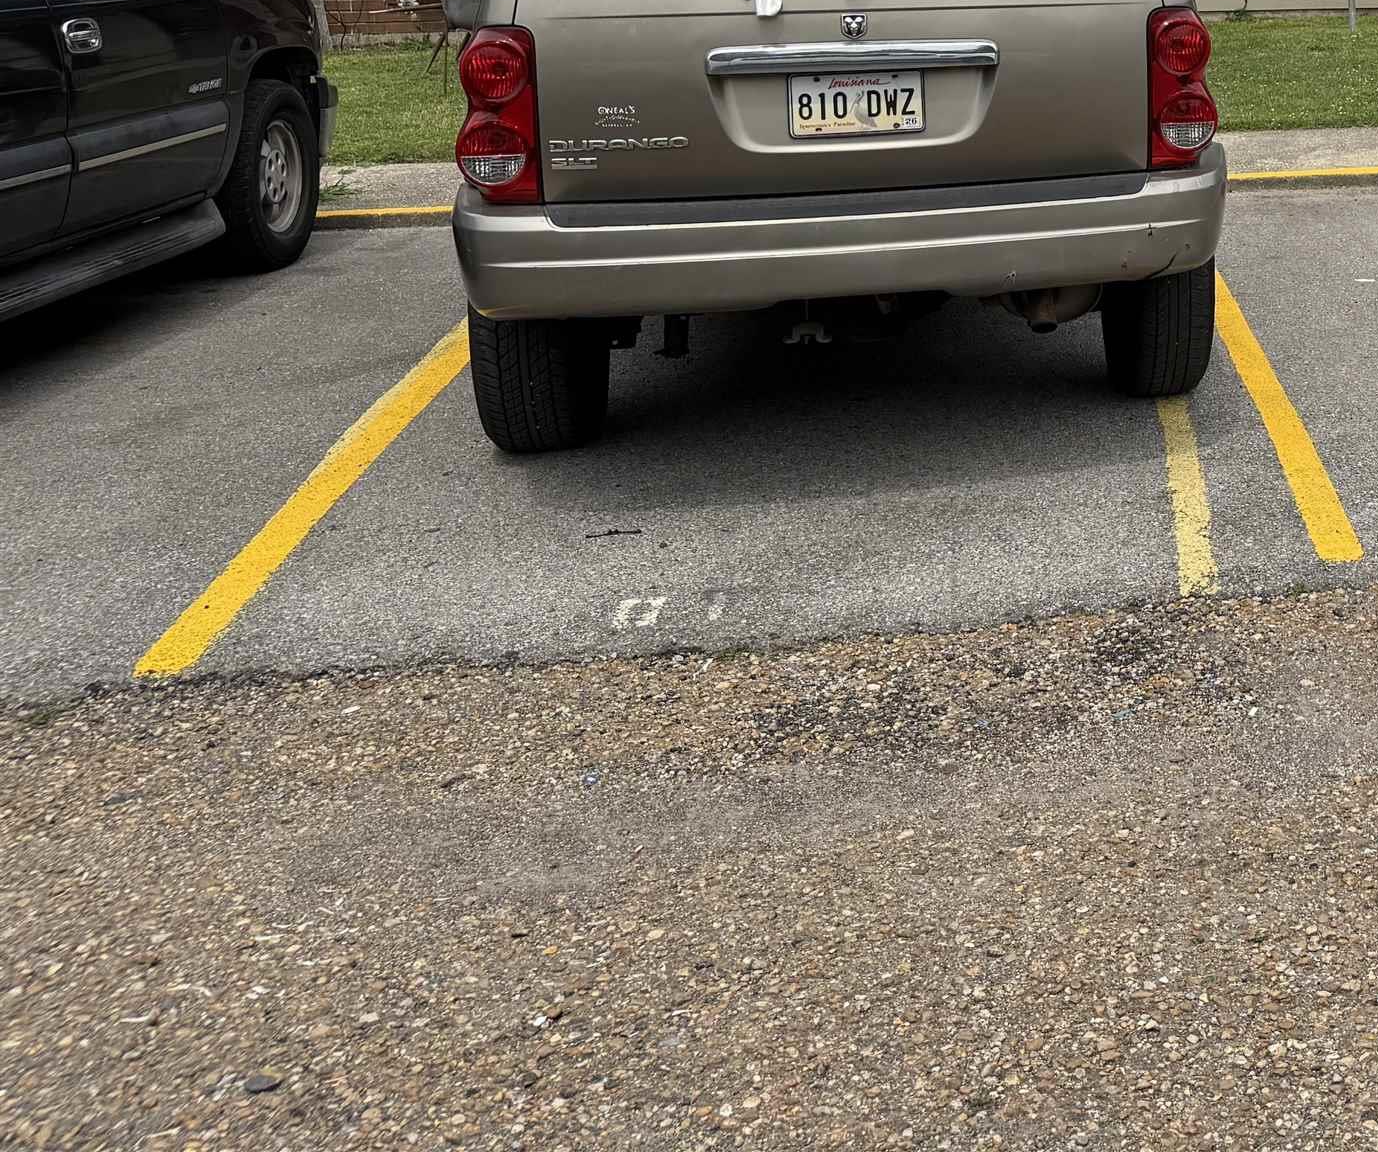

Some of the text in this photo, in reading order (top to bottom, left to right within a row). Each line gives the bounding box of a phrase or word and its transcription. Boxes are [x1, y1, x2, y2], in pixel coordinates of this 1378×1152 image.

[828, 78, 882, 89] Louisiana
[798, 87, 916, 121] 810 DWZ
[548, 135, 689, 153] DURANGO
